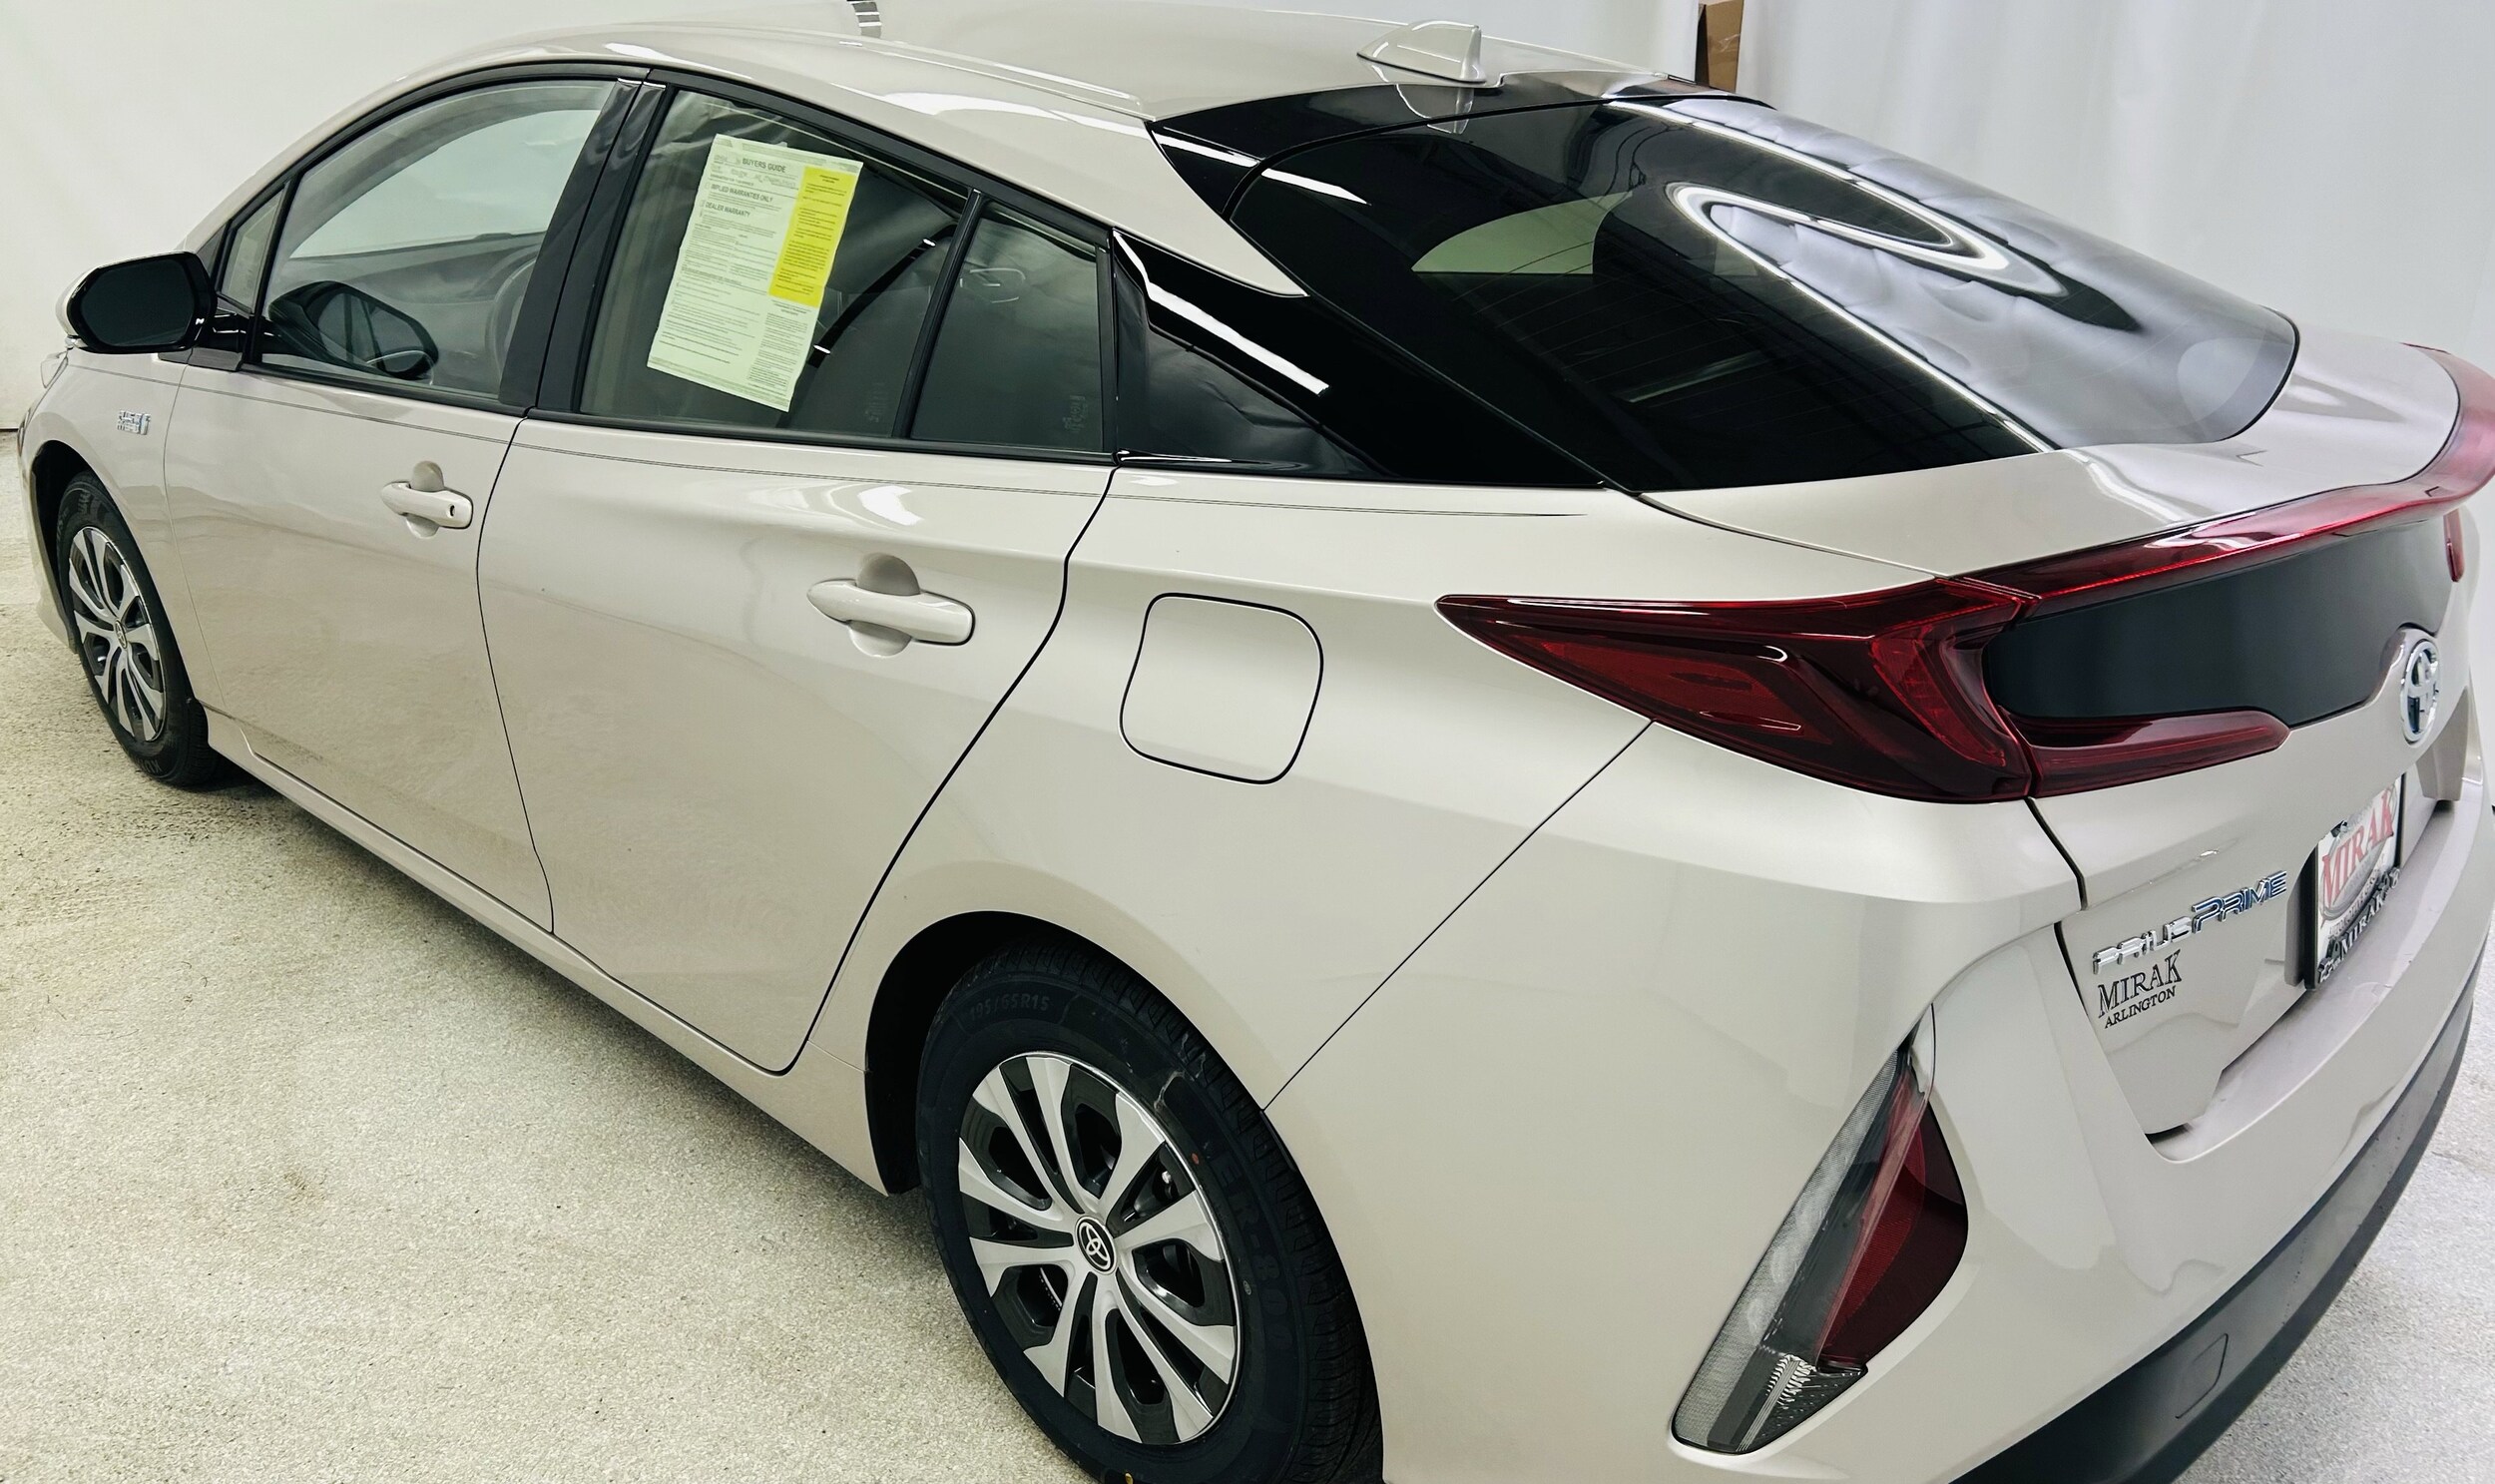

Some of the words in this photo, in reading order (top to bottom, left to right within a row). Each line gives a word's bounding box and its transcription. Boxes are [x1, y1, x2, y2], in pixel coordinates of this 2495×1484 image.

[742, 158, 766, 169] BUYERS
[767, 163, 786, 173] GUIDE
[705, 202, 725, 212] DEALER
[725, 206, 750, 218] WARRANTY
[2321, 786, 2394, 910] MIRAK
[2092, 915, 2193, 975] PRIUS
[2191, 869, 2287, 934] PRIME
[2340, 890, 2386, 961] MIRAK
[968, 992, 1051, 1022] 195/65R15
[2098, 948, 2183, 1018] MIRAK
[2104, 985, 2177, 1029] ARLINGTON
